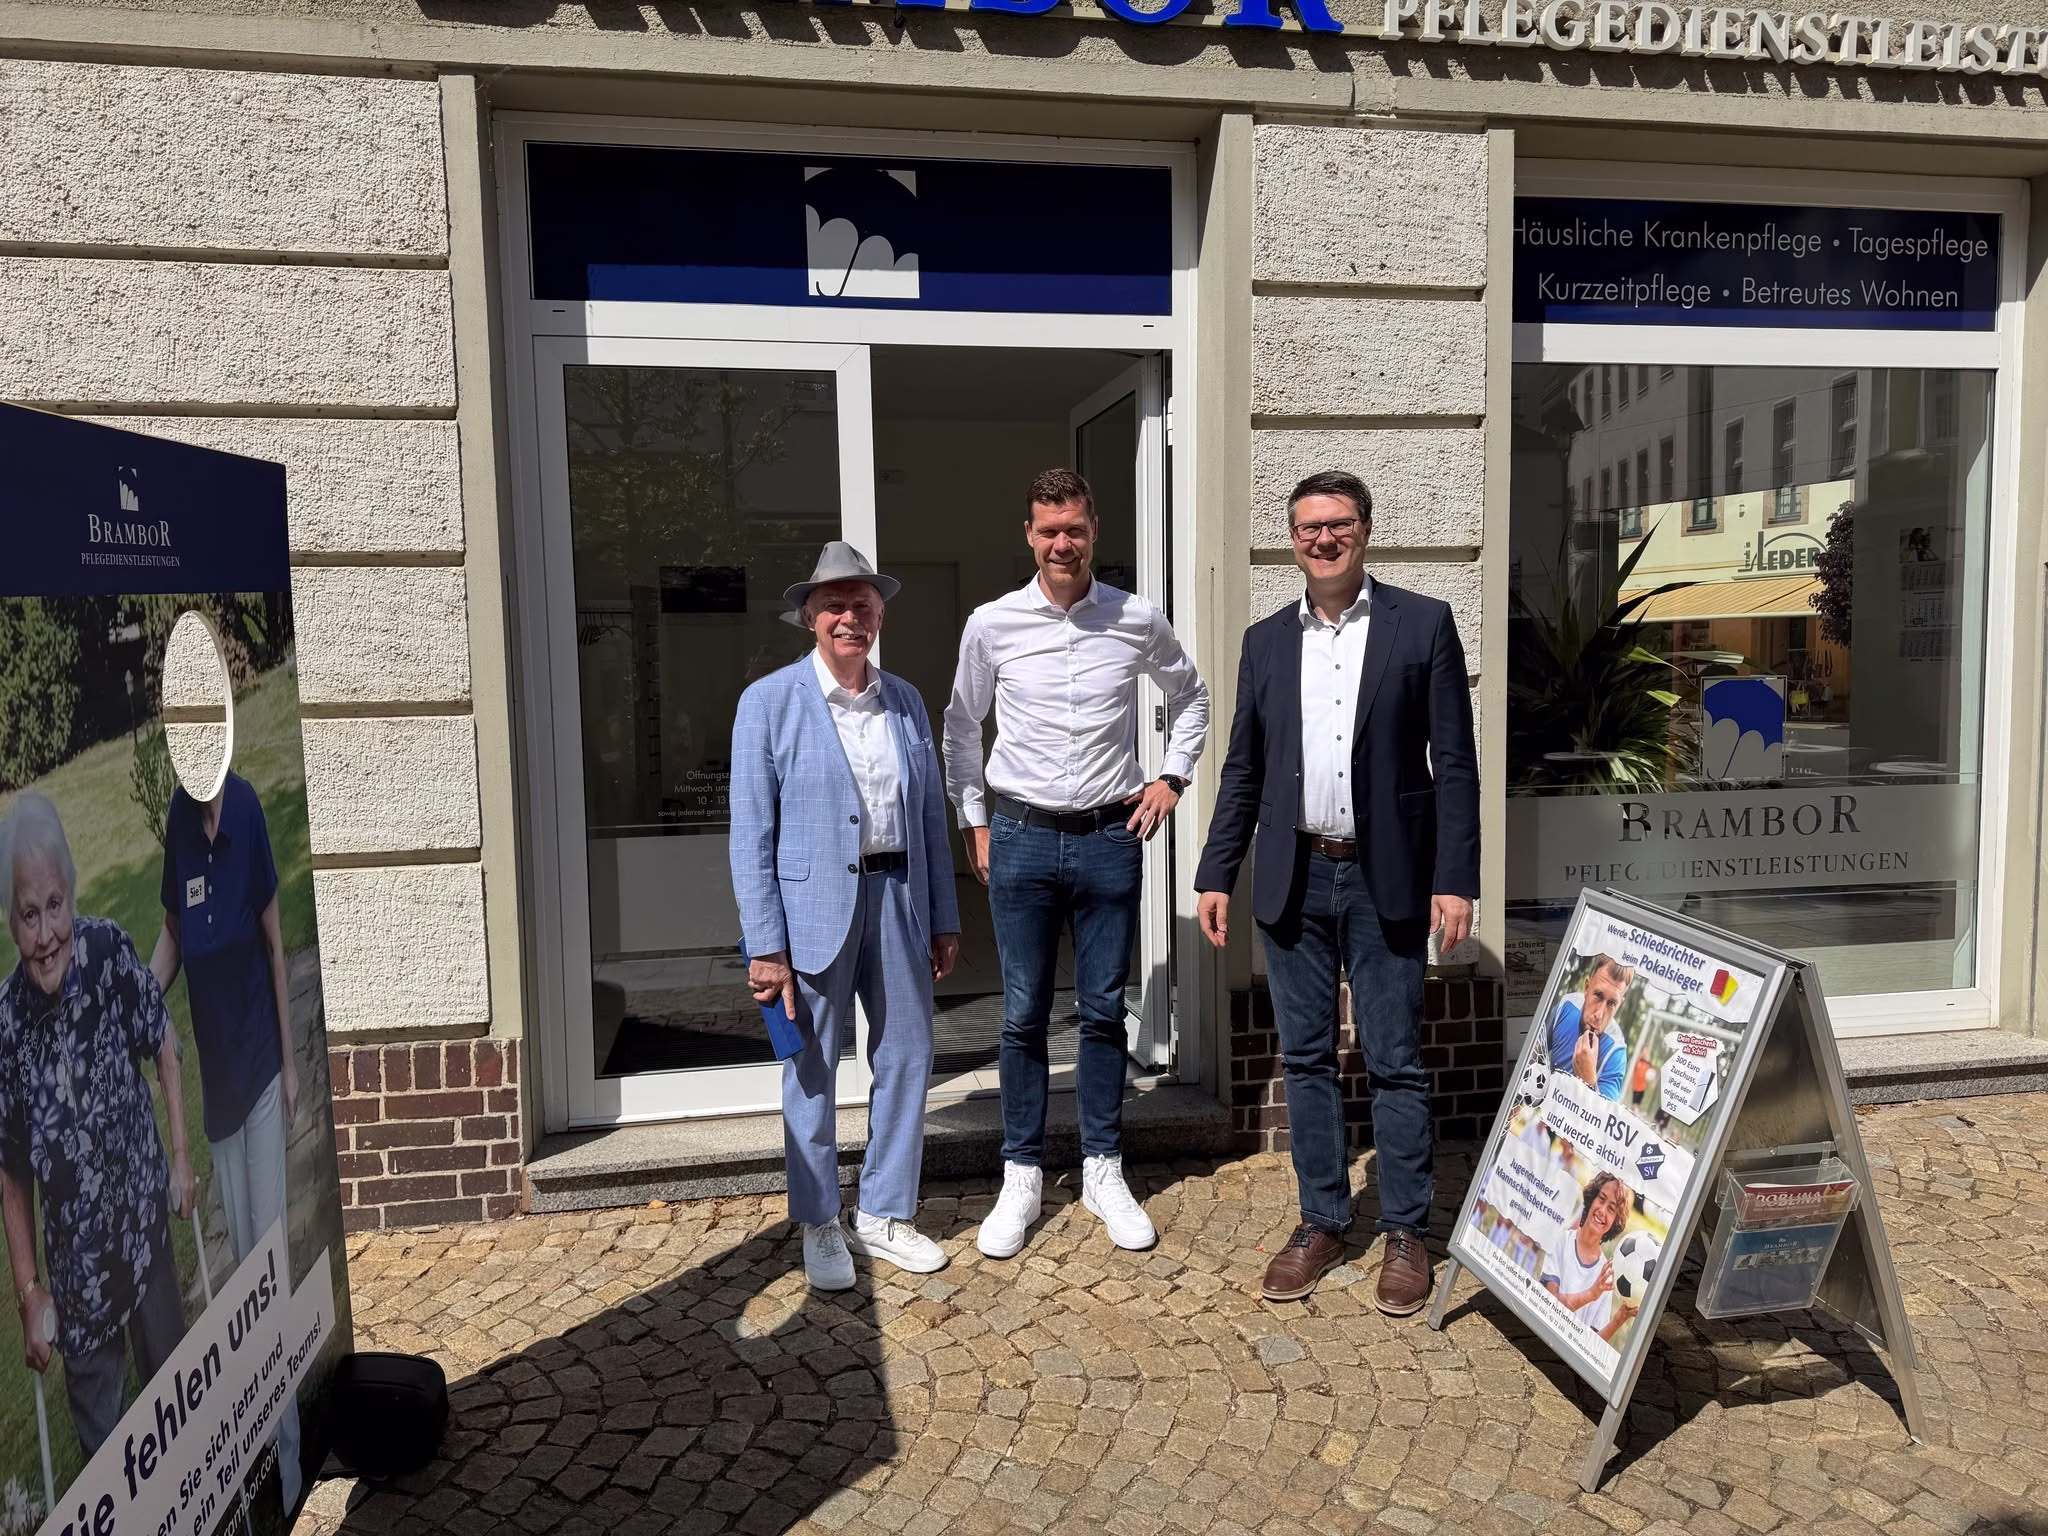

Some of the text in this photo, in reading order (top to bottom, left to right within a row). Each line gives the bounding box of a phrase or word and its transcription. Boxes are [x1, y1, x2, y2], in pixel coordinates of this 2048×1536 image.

[1378, 0, 2048, 79] PFLEGEDIENSTLEIST
[1513, 218, 1988, 263] Häusliche Krankenpflege Tagespflege
[1538, 273, 1958, 309] Kurzzeitpflege Betreutes Wohnen
[88, 513, 171, 546] BRAMBOR
[81, 552, 180, 567] PFLEGEDIENSTLEISTUNGEN
[674, 783, 713, 793] Mittwoch
[686, 769, 730, 781] Öffnungsz
[1618, 795, 1861, 842] BRAMBOR
[1607, 923, 1706, 970] Werde Schiedsrichter
[1622, 951, 1703, 994] beim Pokalsieger.
[1669, 1076, 1680, 1088] iPad
[1670, 1065, 1697, 1085] Zuschuss,
[1676, 1056, 1700, 1073] 300 Euro
[1552, 1087, 1639, 1148] Komm zum RSV
[1664, 1088, 1688, 1105] originale
[1547, 1111, 1625, 1170] und werde aktiv!
[1643, 1166, 1655, 1177] SV
[1496, 1165, 1565, 1224] Mannschaftsbetreuer
[60, 1248, 277, 1536] ie fehlen uns!
[180, 1467, 201, 1510] Sie
[205, 1419, 230, 1472] sich
[232, 1372, 259, 1434] jetzt
[261, 1332, 283, 1381] und
[194, 1311, 321, 1536] ein Teil unseres Teams!
[217, 1439, 280, 1536] rambor.com
